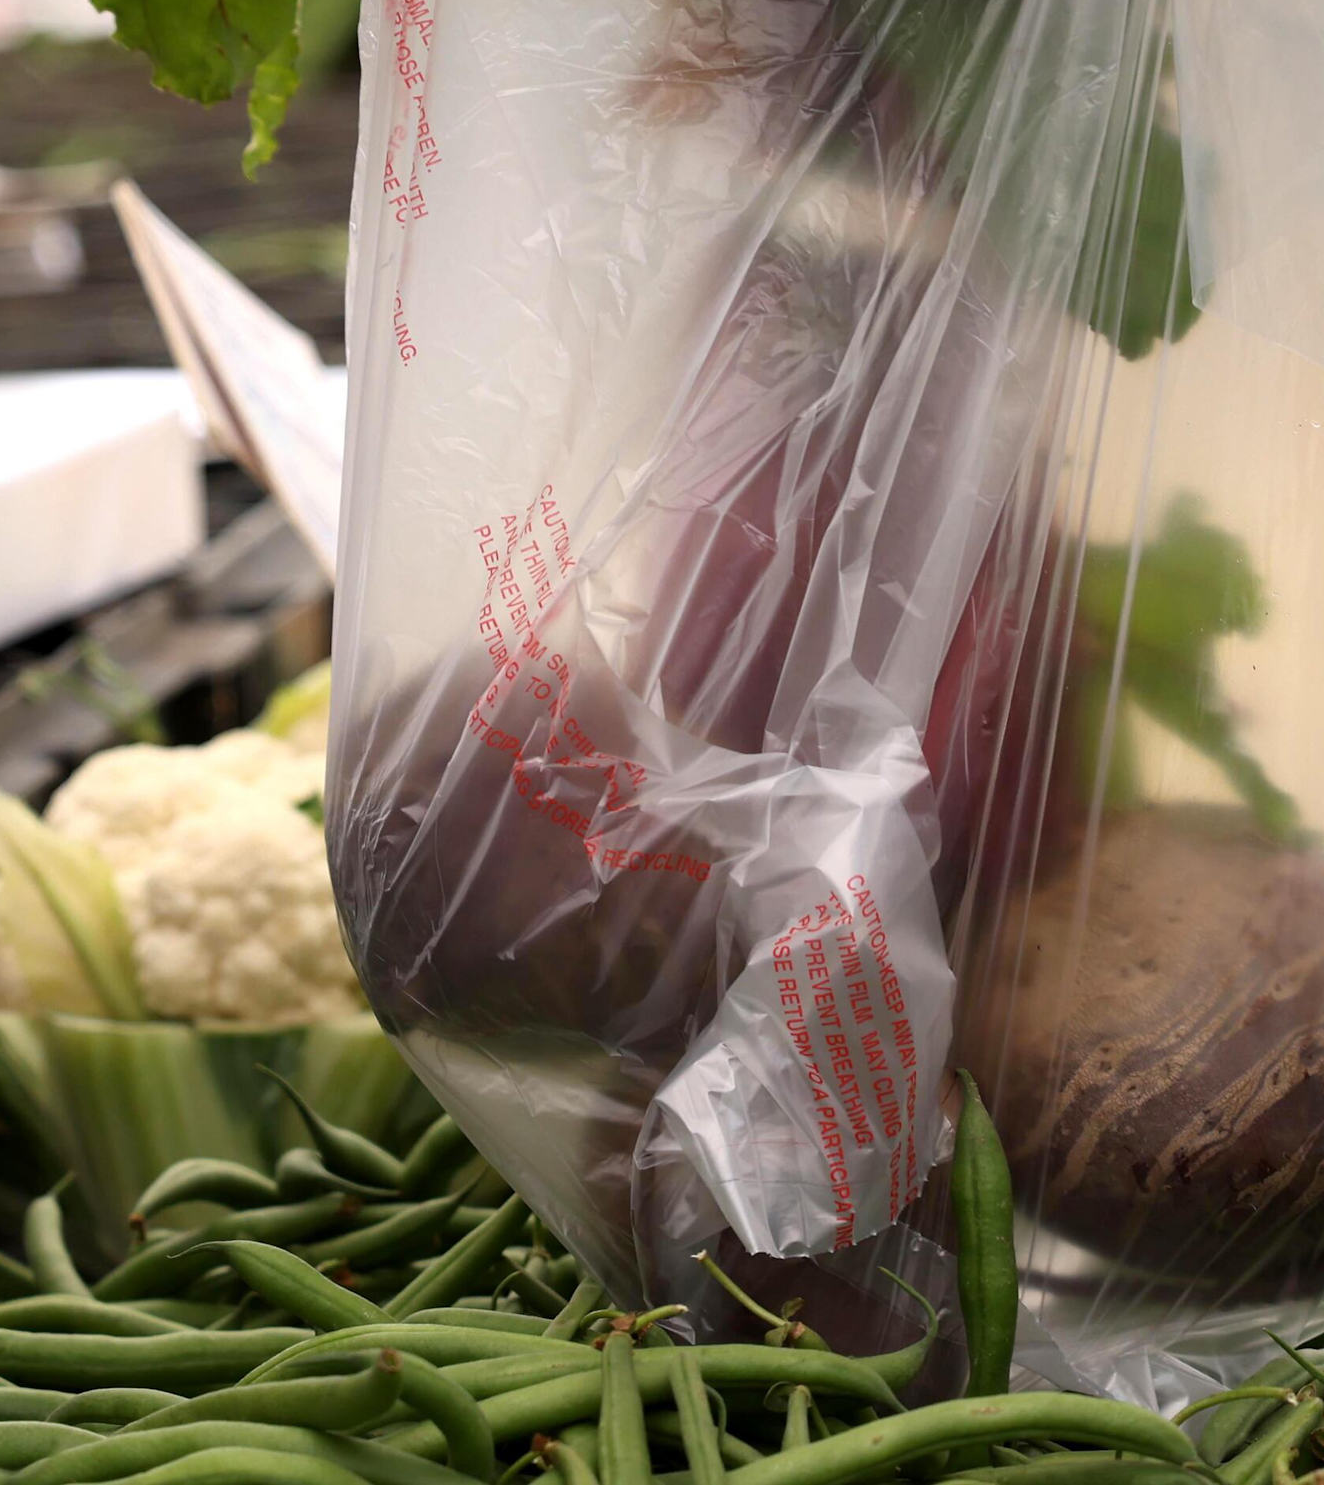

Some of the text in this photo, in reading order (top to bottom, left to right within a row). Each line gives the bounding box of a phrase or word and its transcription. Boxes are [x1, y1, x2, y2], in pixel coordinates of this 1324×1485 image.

[520, 540, 548, 585] THIN
[536, 580, 554, 609] FIL
[524, 676, 553, 701] TO
[601, 847, 712, 883] RECYCLING
[836, 931, 864, 977] THIN
[846, 874, 906, 1015] CAUTION-KEEP
[892, 1019, 917, 1069] AWAY
[777, 978, 815, 1058] RETURN
[847, 980, 875, 1025] FILM
[804, 938, 842, 1028] PREVENT
[826, 1033, 875, 1149] BREATHING.
[861, 1030, 889, 1072] MAY
[804, 1062, 824, 1085] TO
[812, 1088, 830, 1103] A
[873, 1076, 902, 1138] CLING
